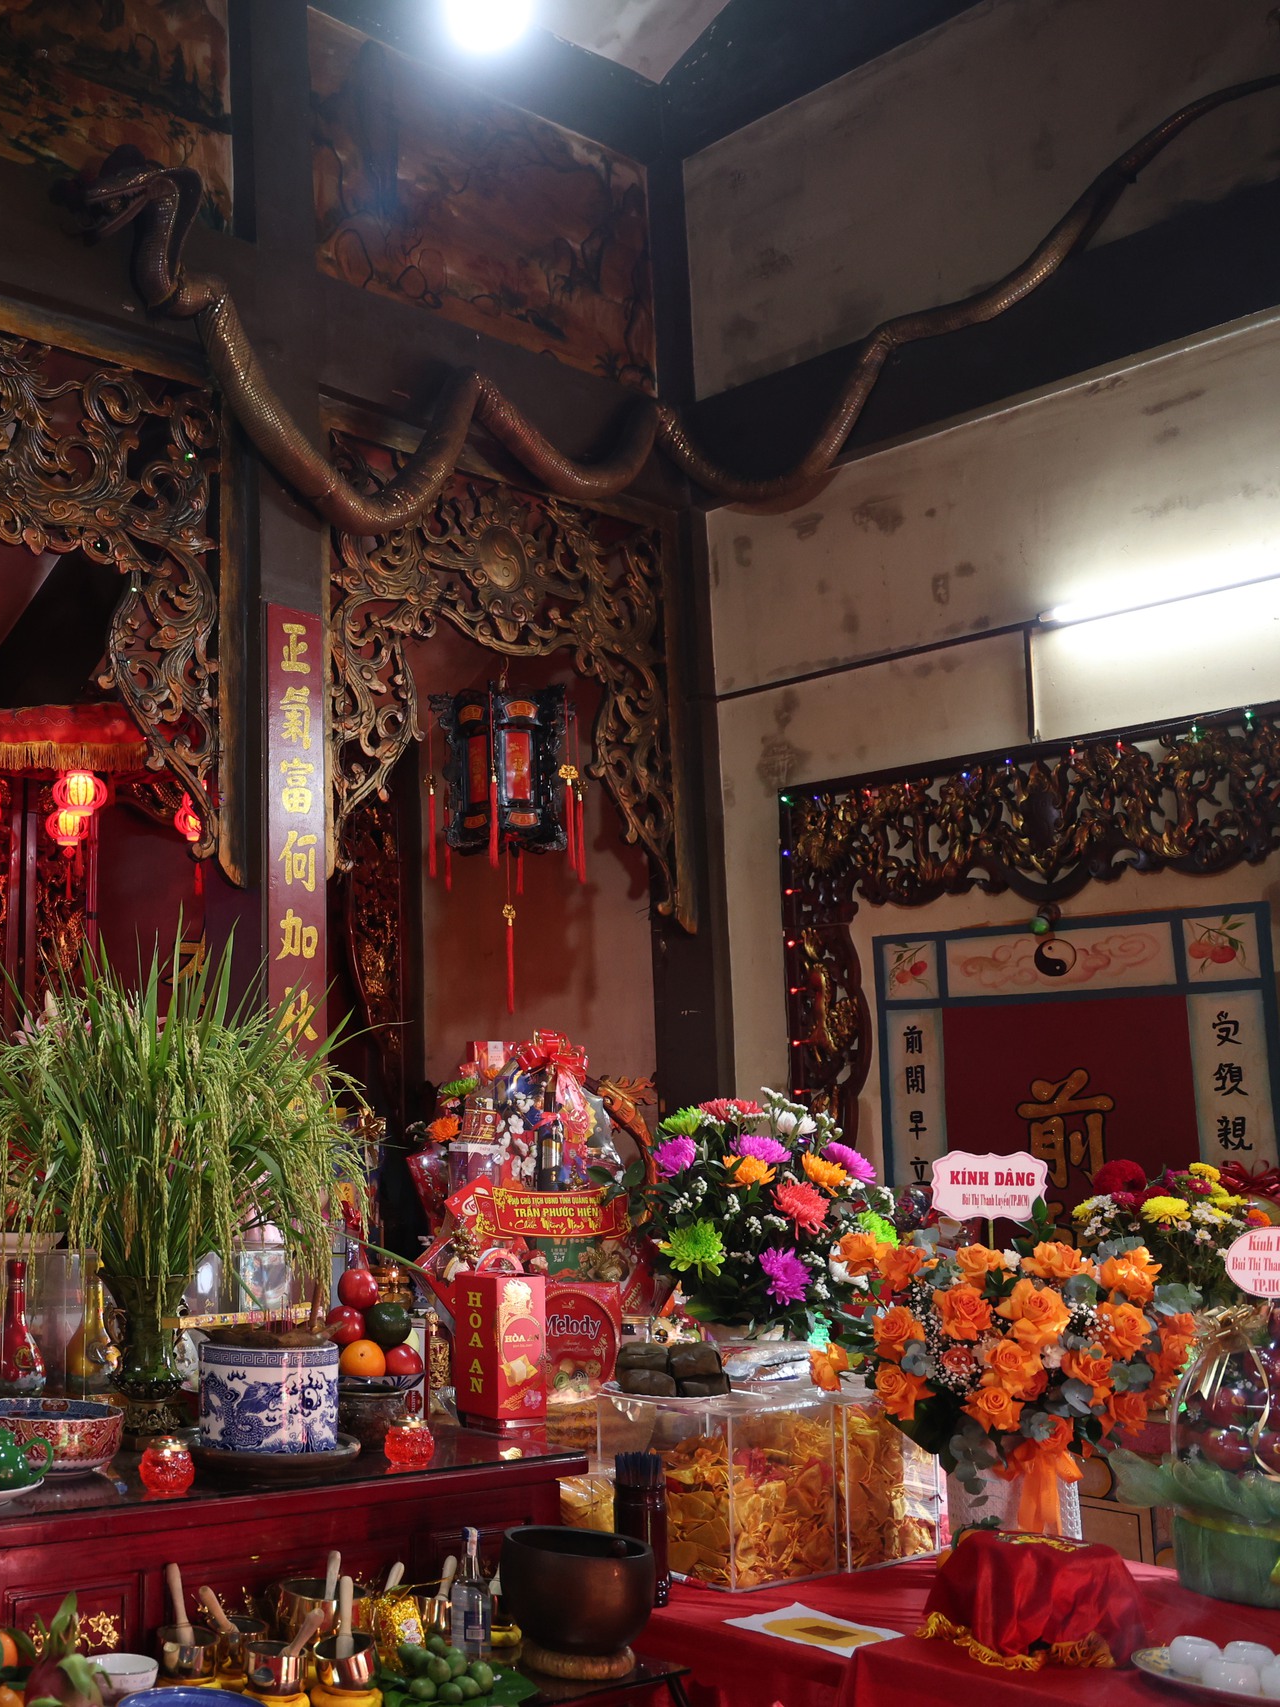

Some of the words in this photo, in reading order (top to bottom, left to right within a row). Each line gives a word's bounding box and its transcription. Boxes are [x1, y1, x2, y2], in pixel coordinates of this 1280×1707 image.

[949, 1167, 989, 1185] KÍNH
[994, 1168, 1036, 1186] DÂNG
[1248, 1235, 1273, 1252] Kính
[620, 1282, 641, 1313] Combo
[545, 1313, 602, 1340] Melody
[504, 1332, 526, 1344] HÒA
